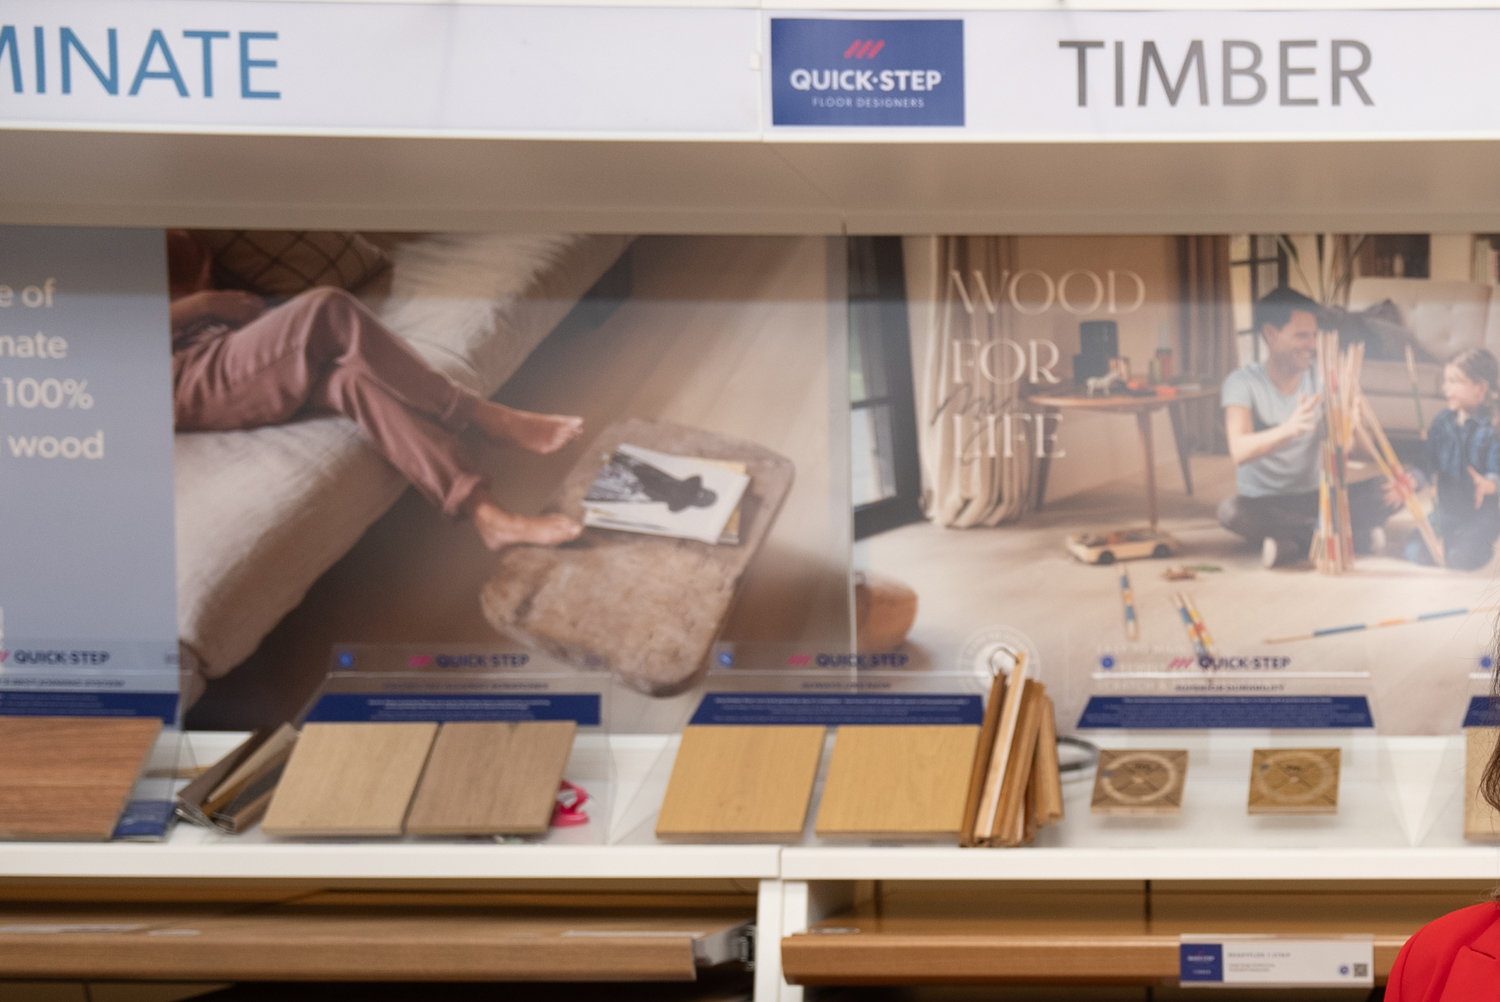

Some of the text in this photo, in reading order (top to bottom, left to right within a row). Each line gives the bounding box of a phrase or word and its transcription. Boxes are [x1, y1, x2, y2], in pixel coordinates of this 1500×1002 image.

[1059, 39, 1375, 107] TIMBER
[811, 96, 925, 108] FLOOR DESIGNERS
[21, 276, 56, 308] of
[950, 268, 1146, 316] WOOD
[952, 338, 1061, 385] FOR
[2, 377, 95, 410] 100%
[7, 429, 105, 459] wood
[952, 412, 1066, 459] LIFE
